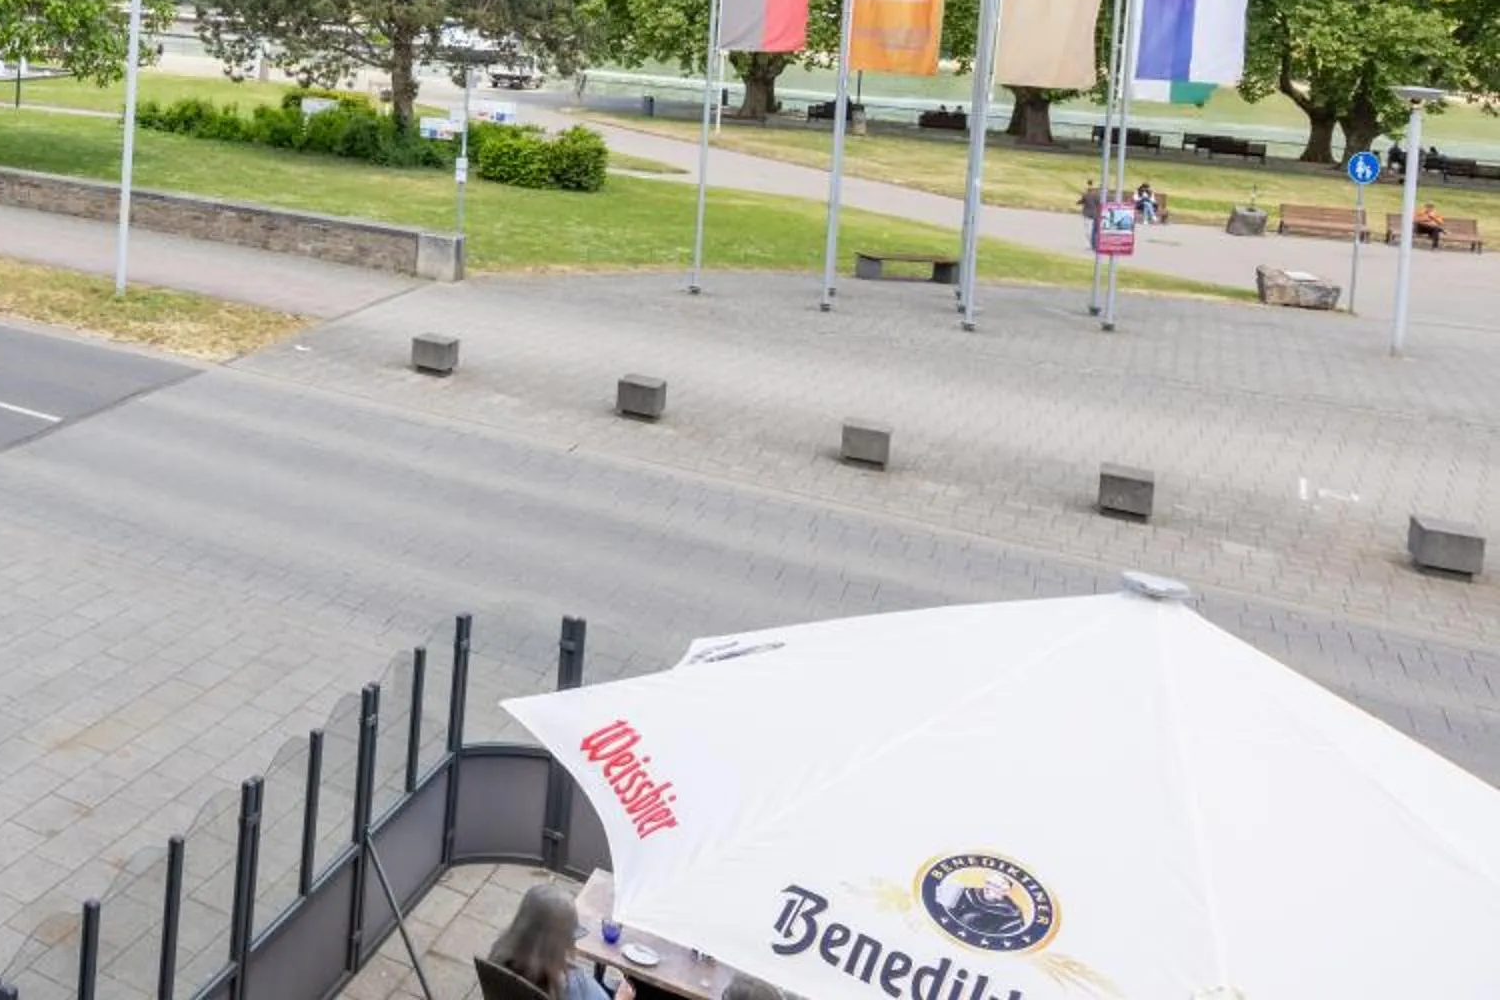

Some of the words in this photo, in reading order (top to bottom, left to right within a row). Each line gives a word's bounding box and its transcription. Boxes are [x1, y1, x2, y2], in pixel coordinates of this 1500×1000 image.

[580, 719, 677, 840] Weissbier
[772, 884, 1021, 1000] Benedi
[931, 855, 1049, 925] BENEDIKTINER
